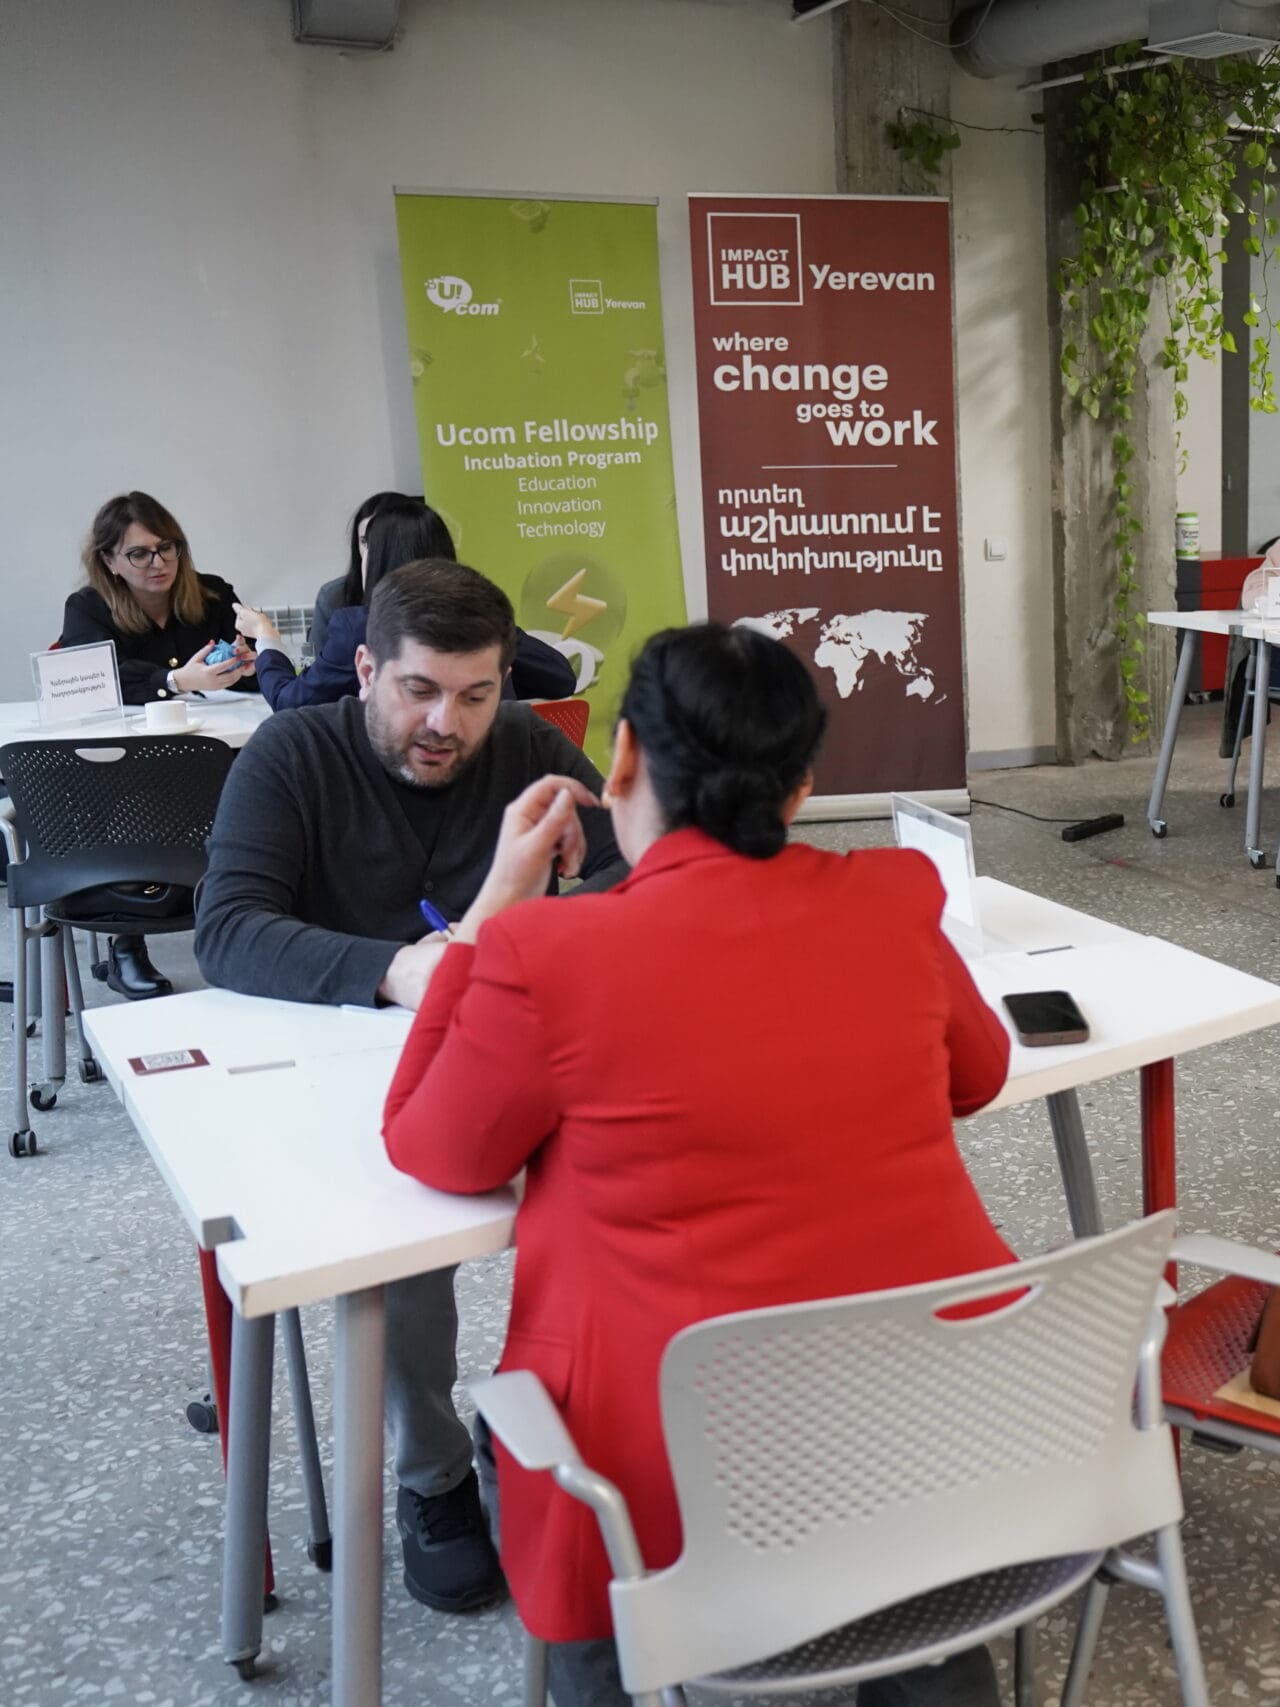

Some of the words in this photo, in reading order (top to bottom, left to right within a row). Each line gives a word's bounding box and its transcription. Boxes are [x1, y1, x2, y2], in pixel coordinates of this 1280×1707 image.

[721, 248, 789, 262] IMPACT
[721, 263, 791, 290] HUB
[808, 264, 935, 291] Yerevan
[574, 299, 599, 309] HUB
[605, 298, 646, 310] Yerevan
[712, 331, 789, 352] where
[713, 354, 889, 400] change
[796, 401, 854, 423] goes
[860, 400, 885, 418] to
[436, 423, 516, 447] Ucom
[524, 416, 659, 446] Fellowship
[825, 409, 939, 447] work
[463, 454, 563, 471] Incubation
[567, 450, 642, 470] Program
[518, 475, 597, 493] Education
[517, 497, 602, 515] Innovation
[718, 484, 804, 508] որտեղ
[516, 519, 607, 538] Technology
[719, 505, 917, 544] աշխատում
[922, 504, 941, 533] է
[721, 544, 943, 575] փոփոխությունը
